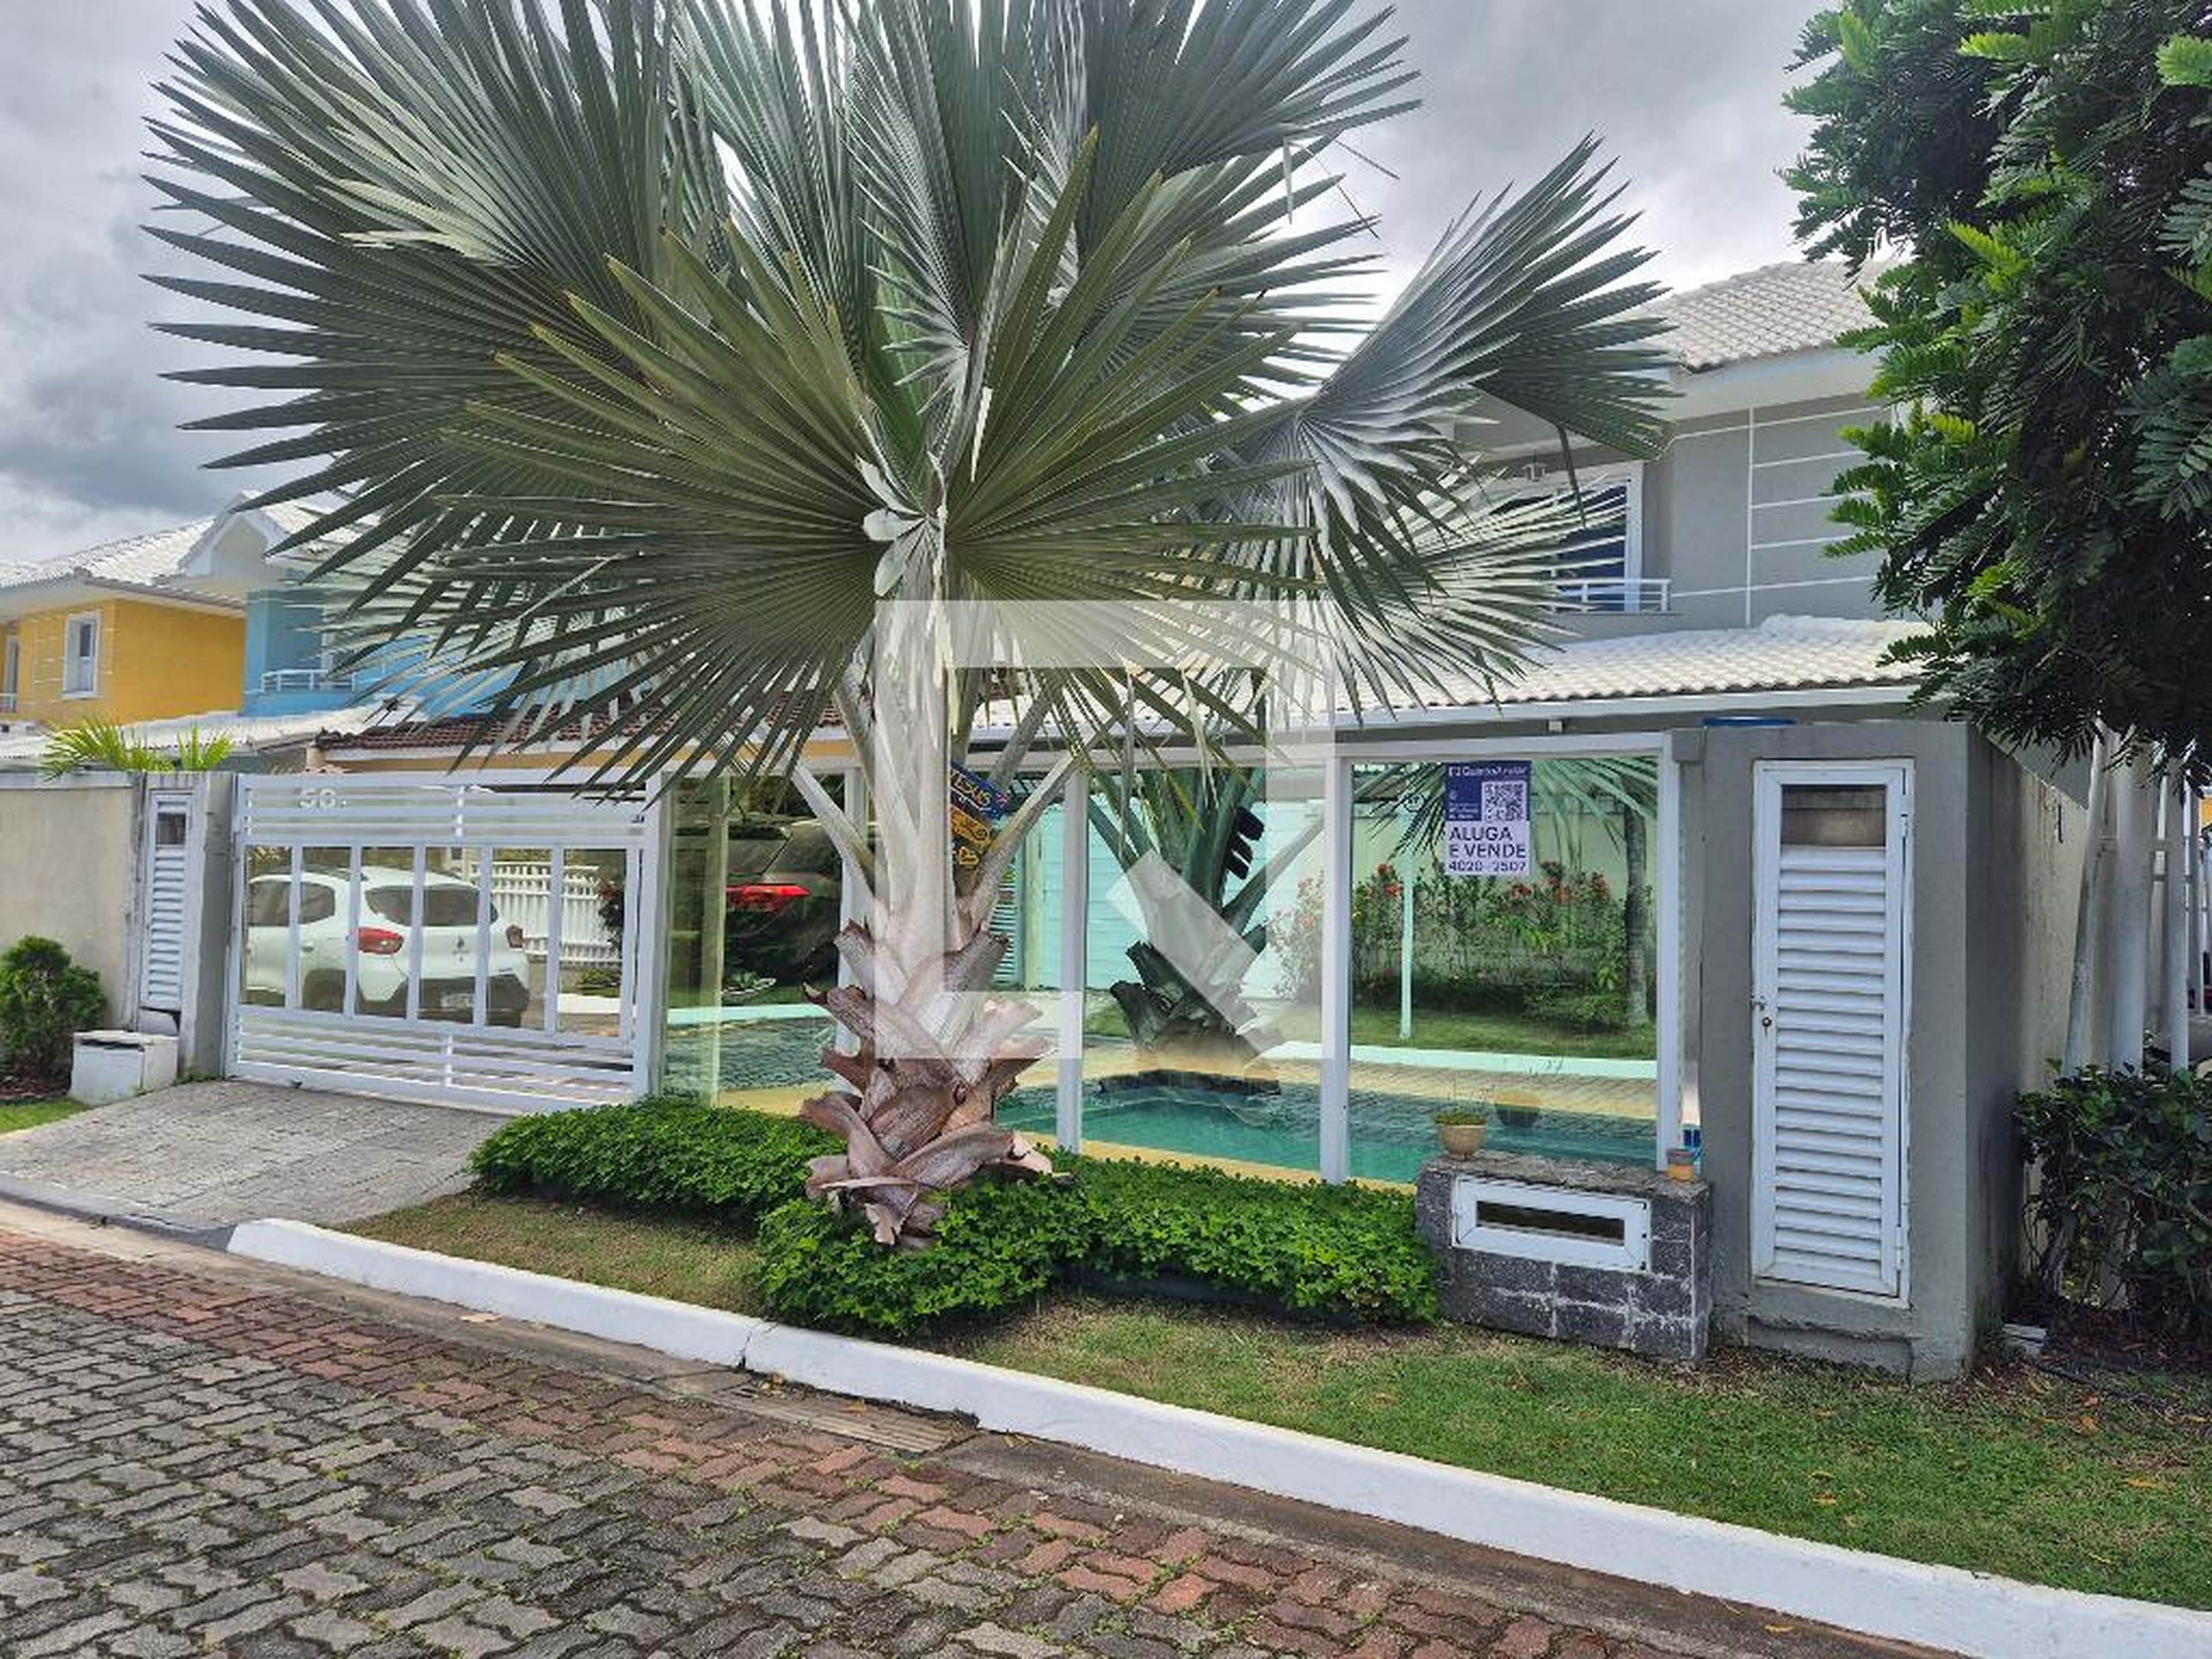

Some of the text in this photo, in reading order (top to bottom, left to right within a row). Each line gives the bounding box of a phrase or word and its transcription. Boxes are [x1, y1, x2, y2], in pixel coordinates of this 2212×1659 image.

[1449, 827, 1513, 841] ALUGA
[1449, 844, 1526, 858] E VENDE
